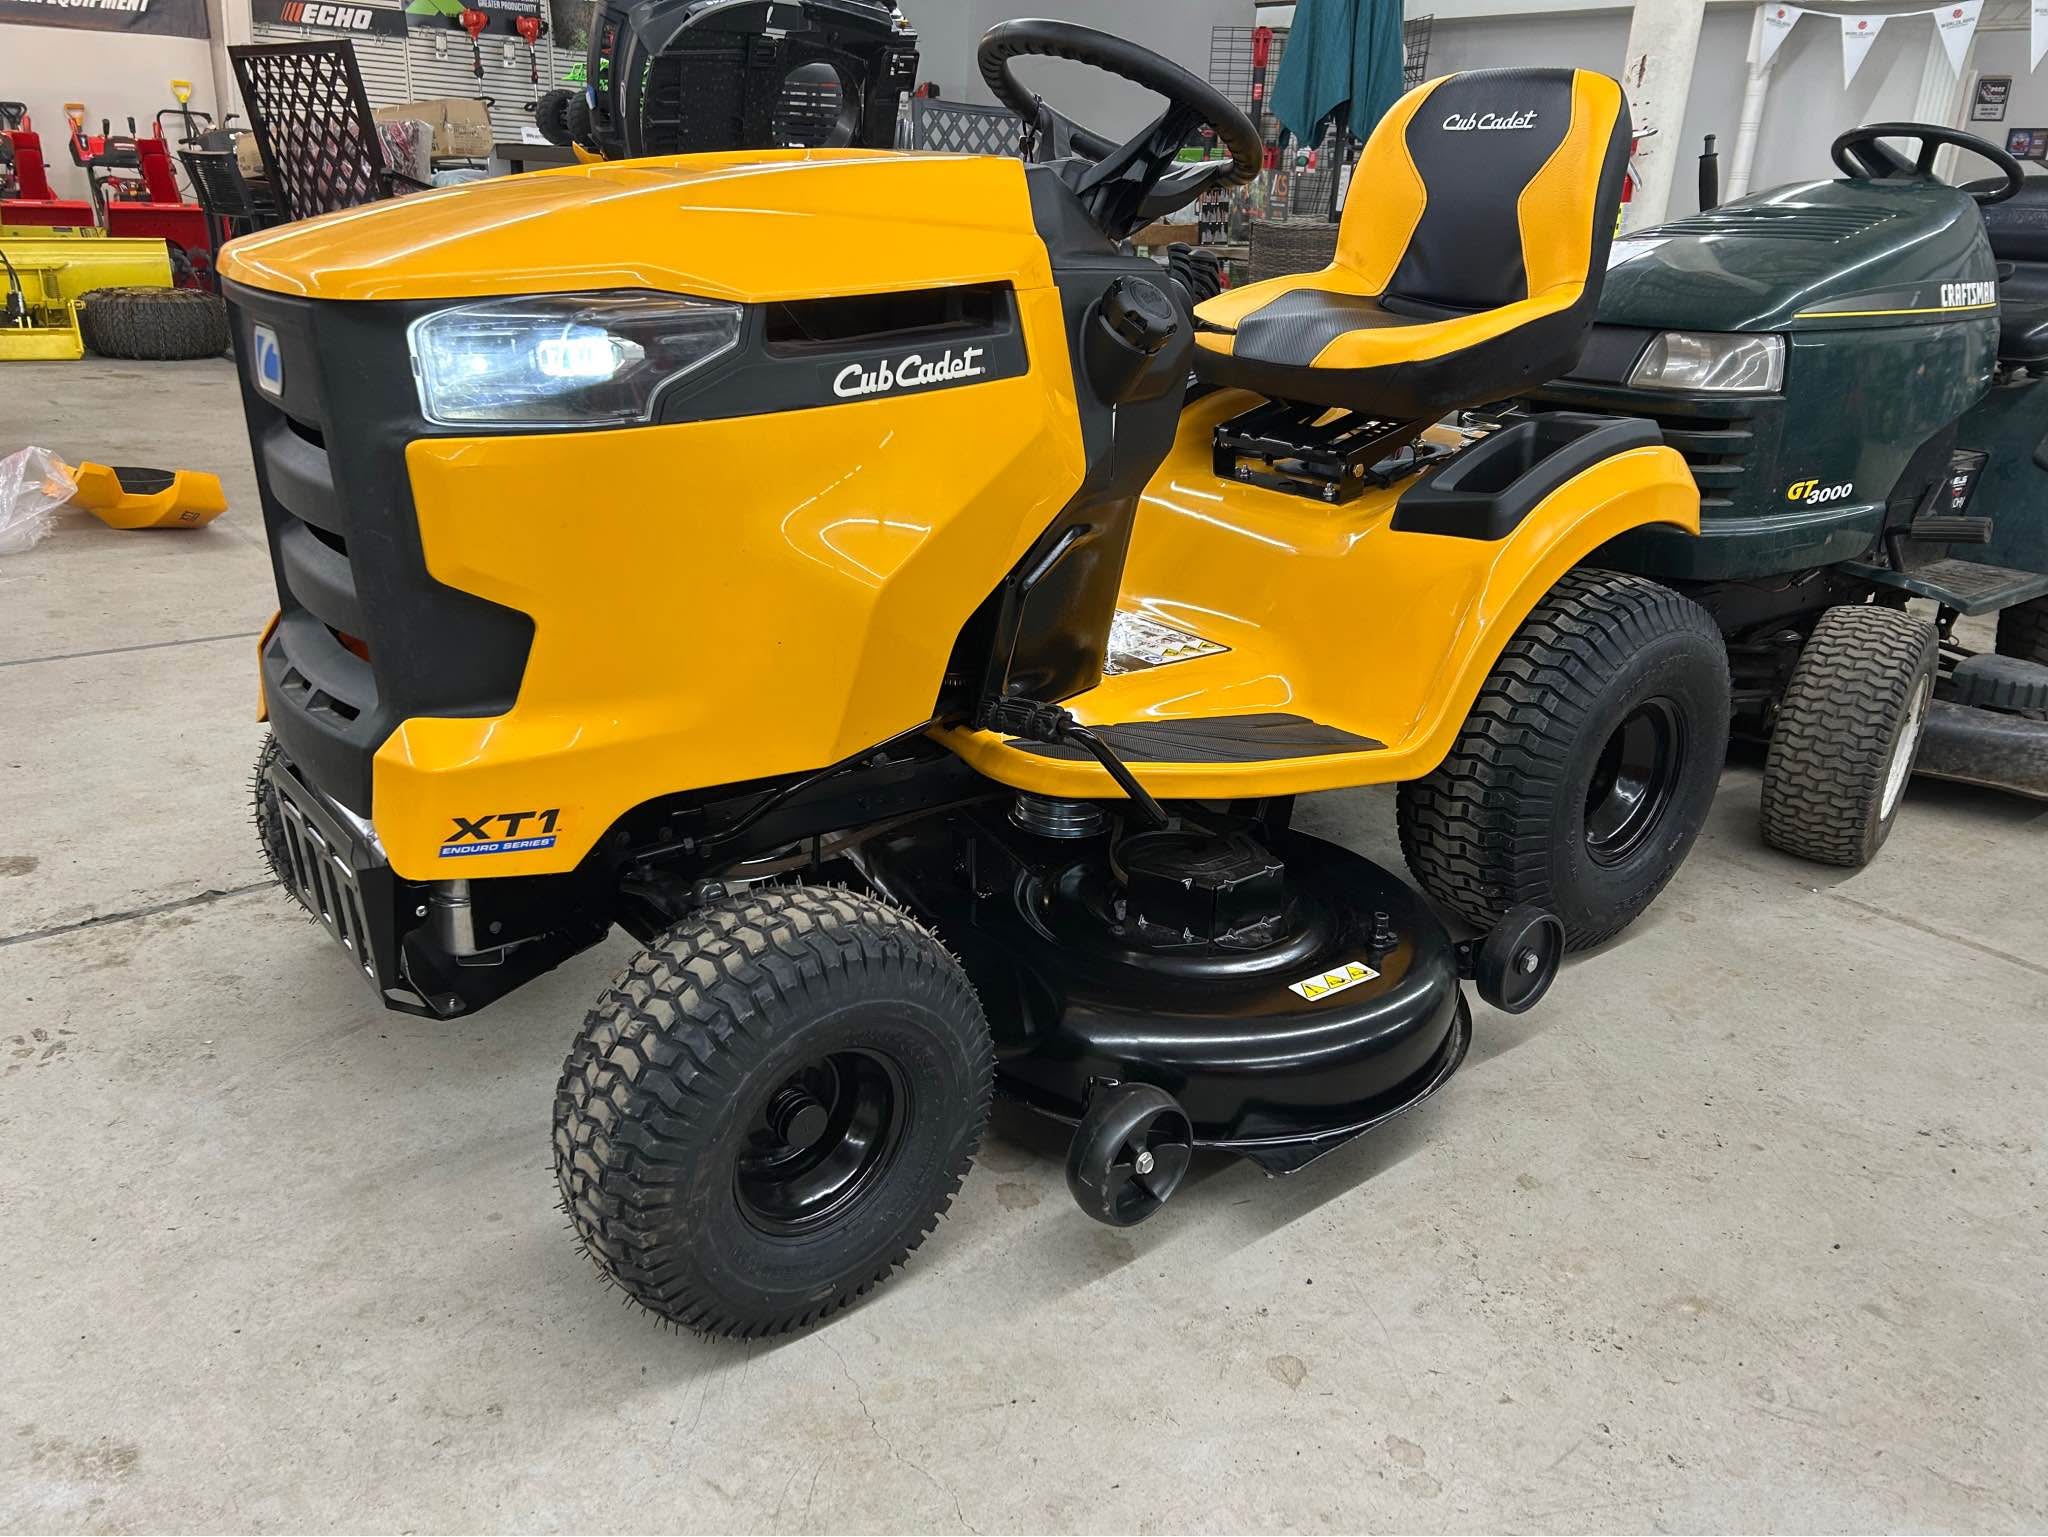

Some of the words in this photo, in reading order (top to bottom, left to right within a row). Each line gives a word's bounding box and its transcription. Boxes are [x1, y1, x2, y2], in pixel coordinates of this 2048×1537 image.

[301, 3, 373, 30] ECHO
[501, 1, 537, 13] PRODUCTIVITY
[1442, 112, 1477, 131] Cub
[1477, 109, 1538, 130] Cadet
[1941, 280, 1996, 308] CRAFTSMAN
[833, 360, 894, 398] Cub
[895, 347, 984, 387] Cadet
[1787, 479, 1819, 501] GT
[1806, 483, 1853, 505] 3000
[443, 808, 560, 843] XT1
[441, 843, 500, 856] ENDURO
[502, 837, 551, 850] SERIES
